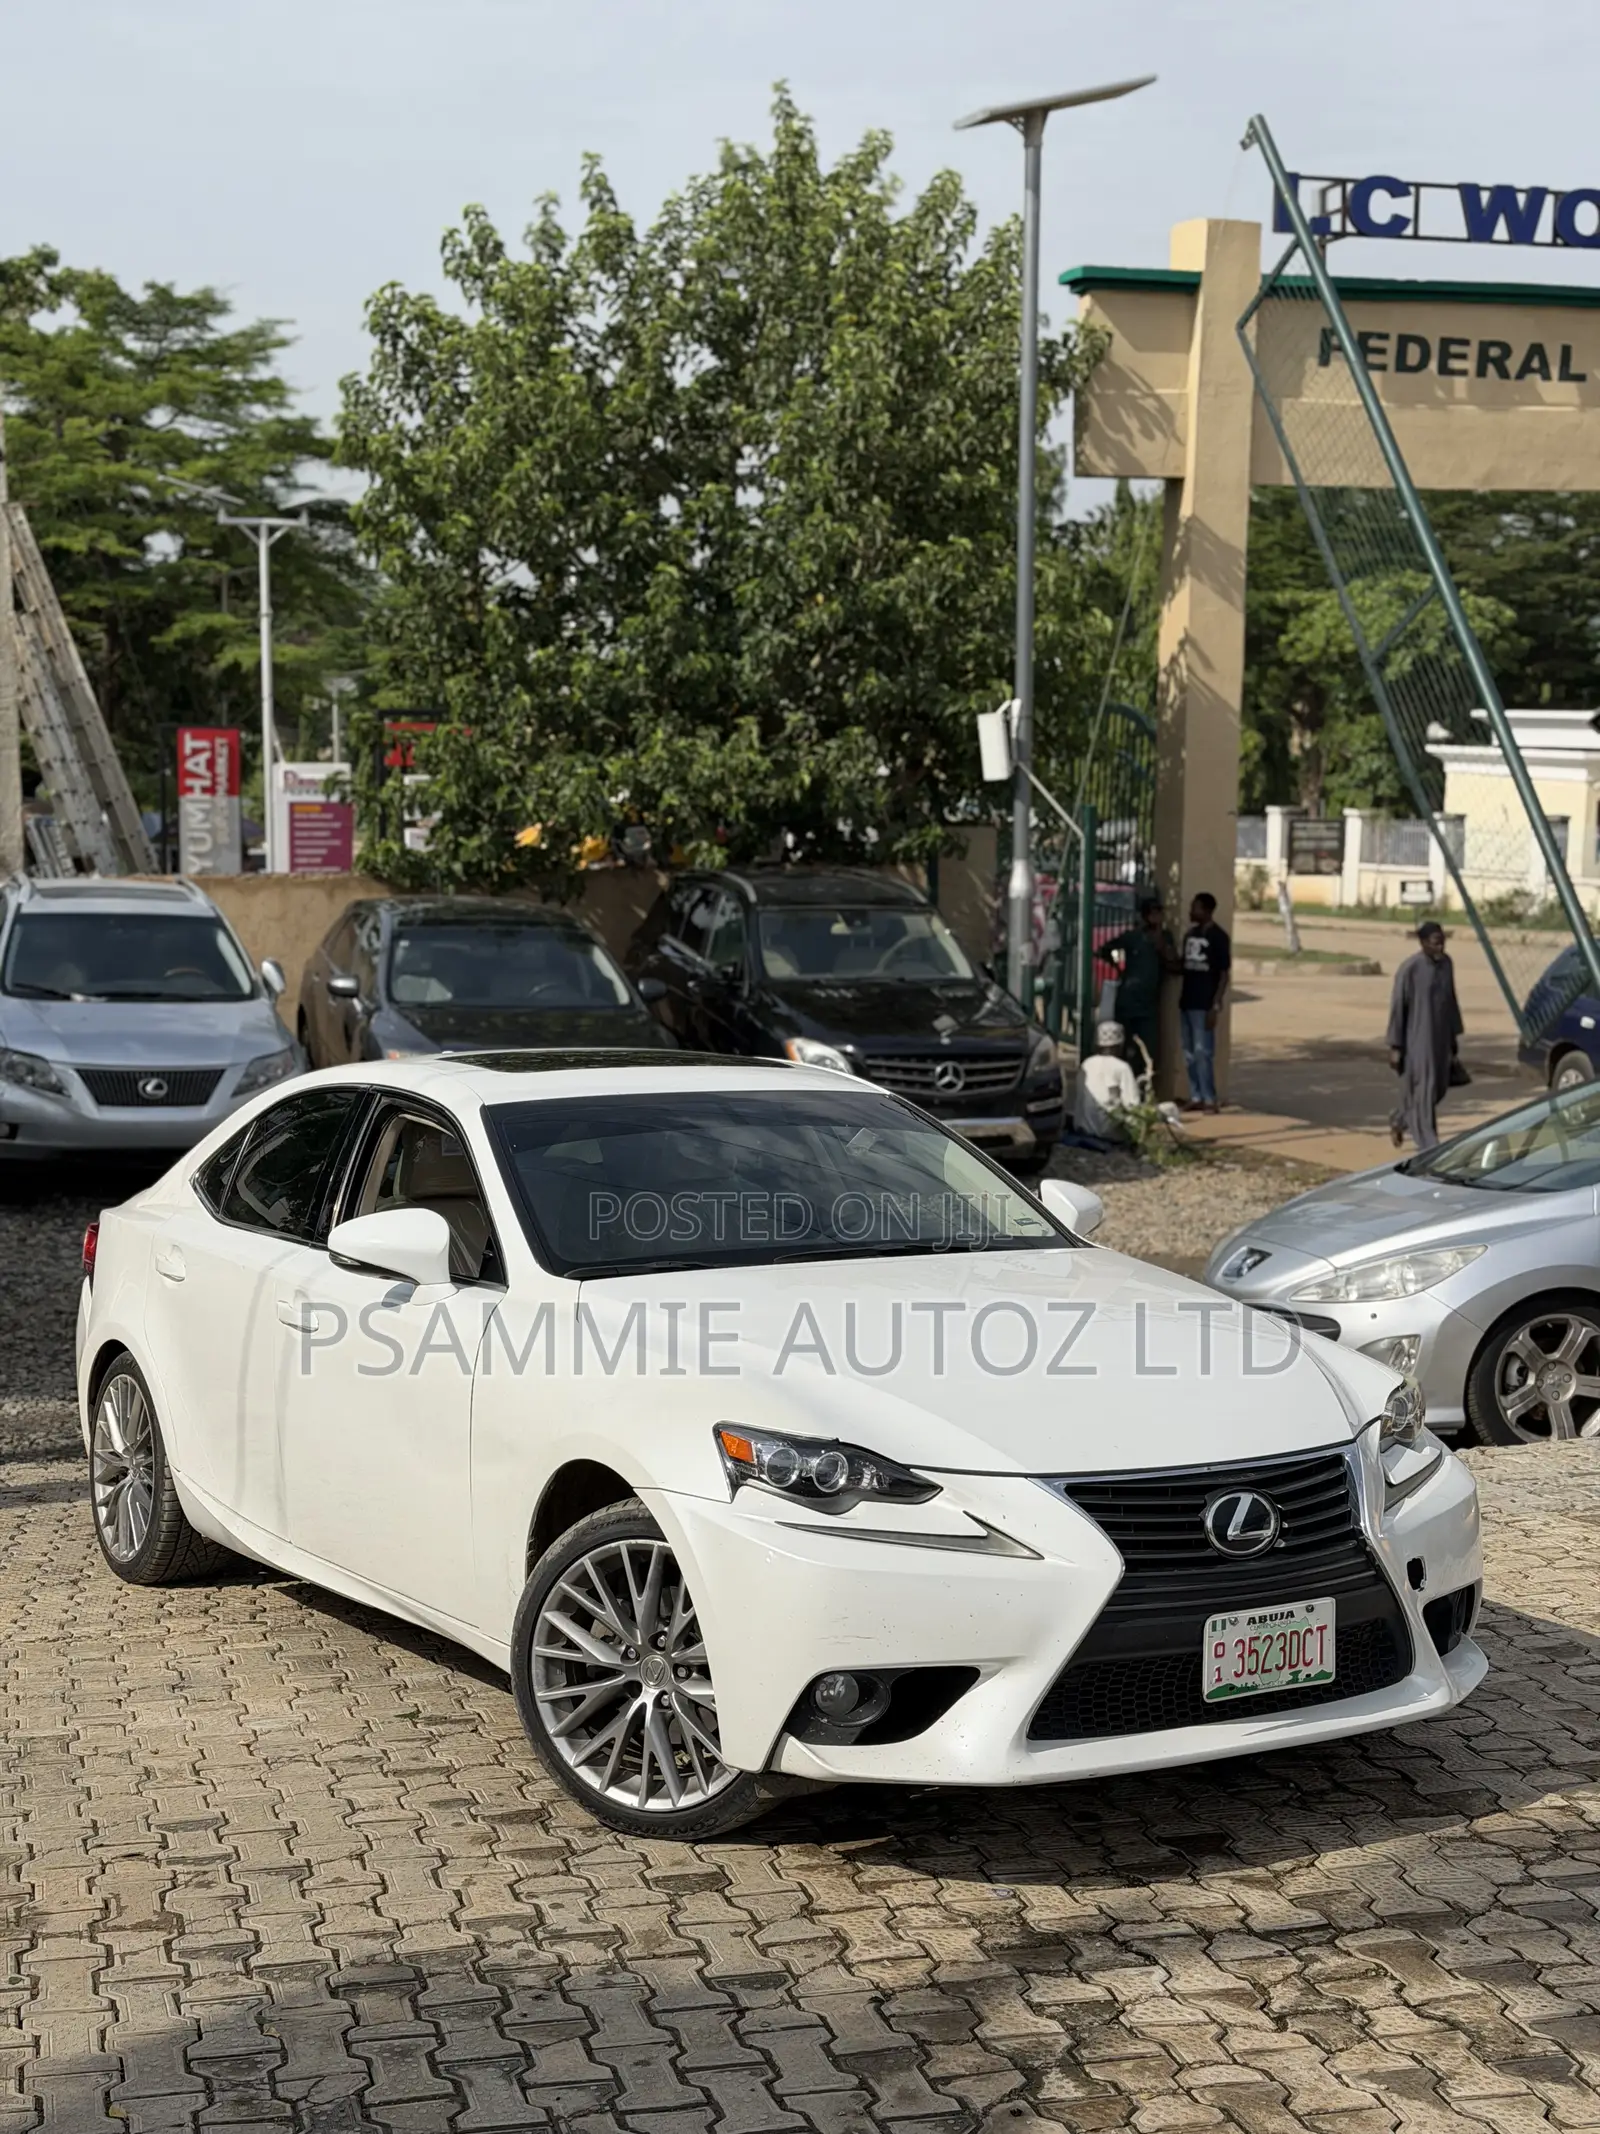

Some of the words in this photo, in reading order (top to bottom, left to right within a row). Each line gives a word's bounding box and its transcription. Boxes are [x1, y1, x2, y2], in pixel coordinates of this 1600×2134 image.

[1318, 327, 1588, 383] FEDERAL
[184, 731, 213, 875] YUMHAT
[1246, 1610, 1296, 1626] ABUJA
[1232, 1624, 1328, 1679] 3523DCT
